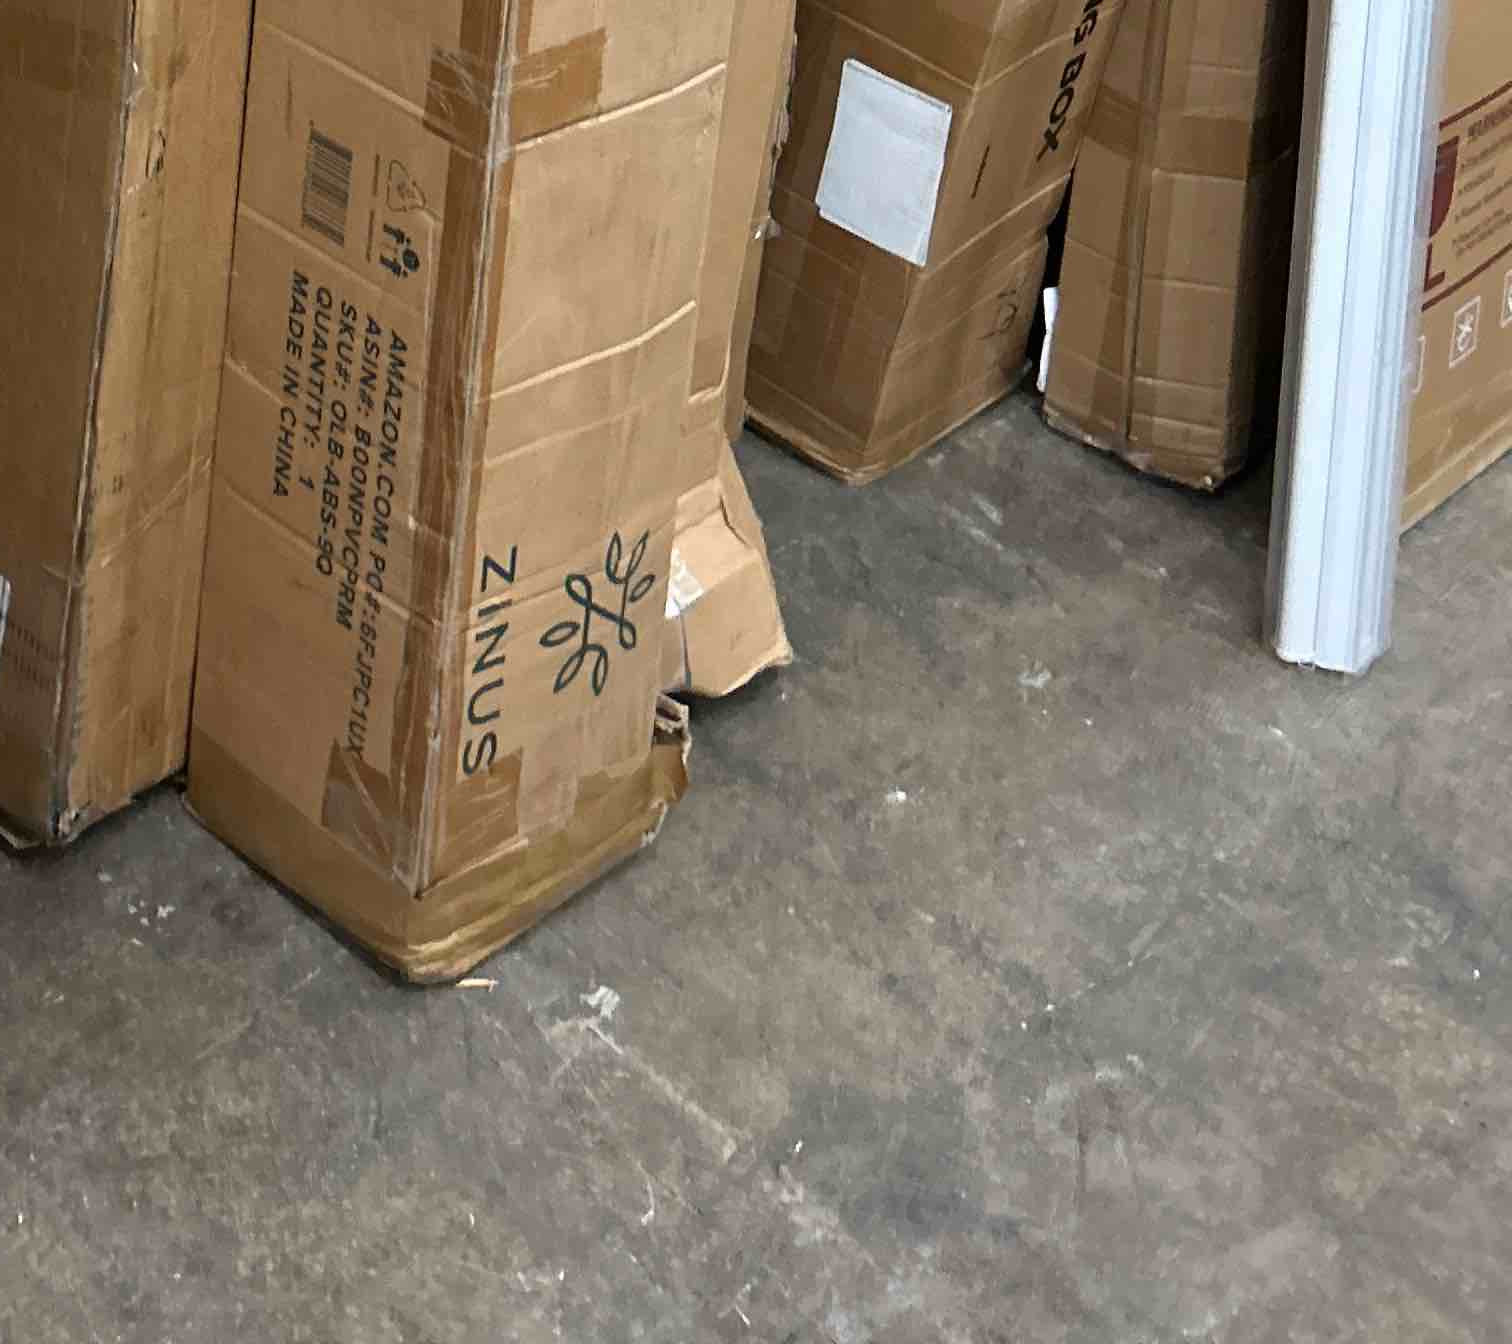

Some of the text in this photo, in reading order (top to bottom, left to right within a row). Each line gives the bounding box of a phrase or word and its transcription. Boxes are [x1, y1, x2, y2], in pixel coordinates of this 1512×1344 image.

[1035, 54, 1085, 163] BOX
[272, 269, 311, 499] MADE IN CHINA
[298, 286, 334, 491] QUANTITY: 1
[331, 299, 358, 392] SKU#:
[356, 314, 383, 418] ASIN#:
[368, 329, 409, 546] AMAZON.COM
[462, 544, 518, 777] ZINUS
